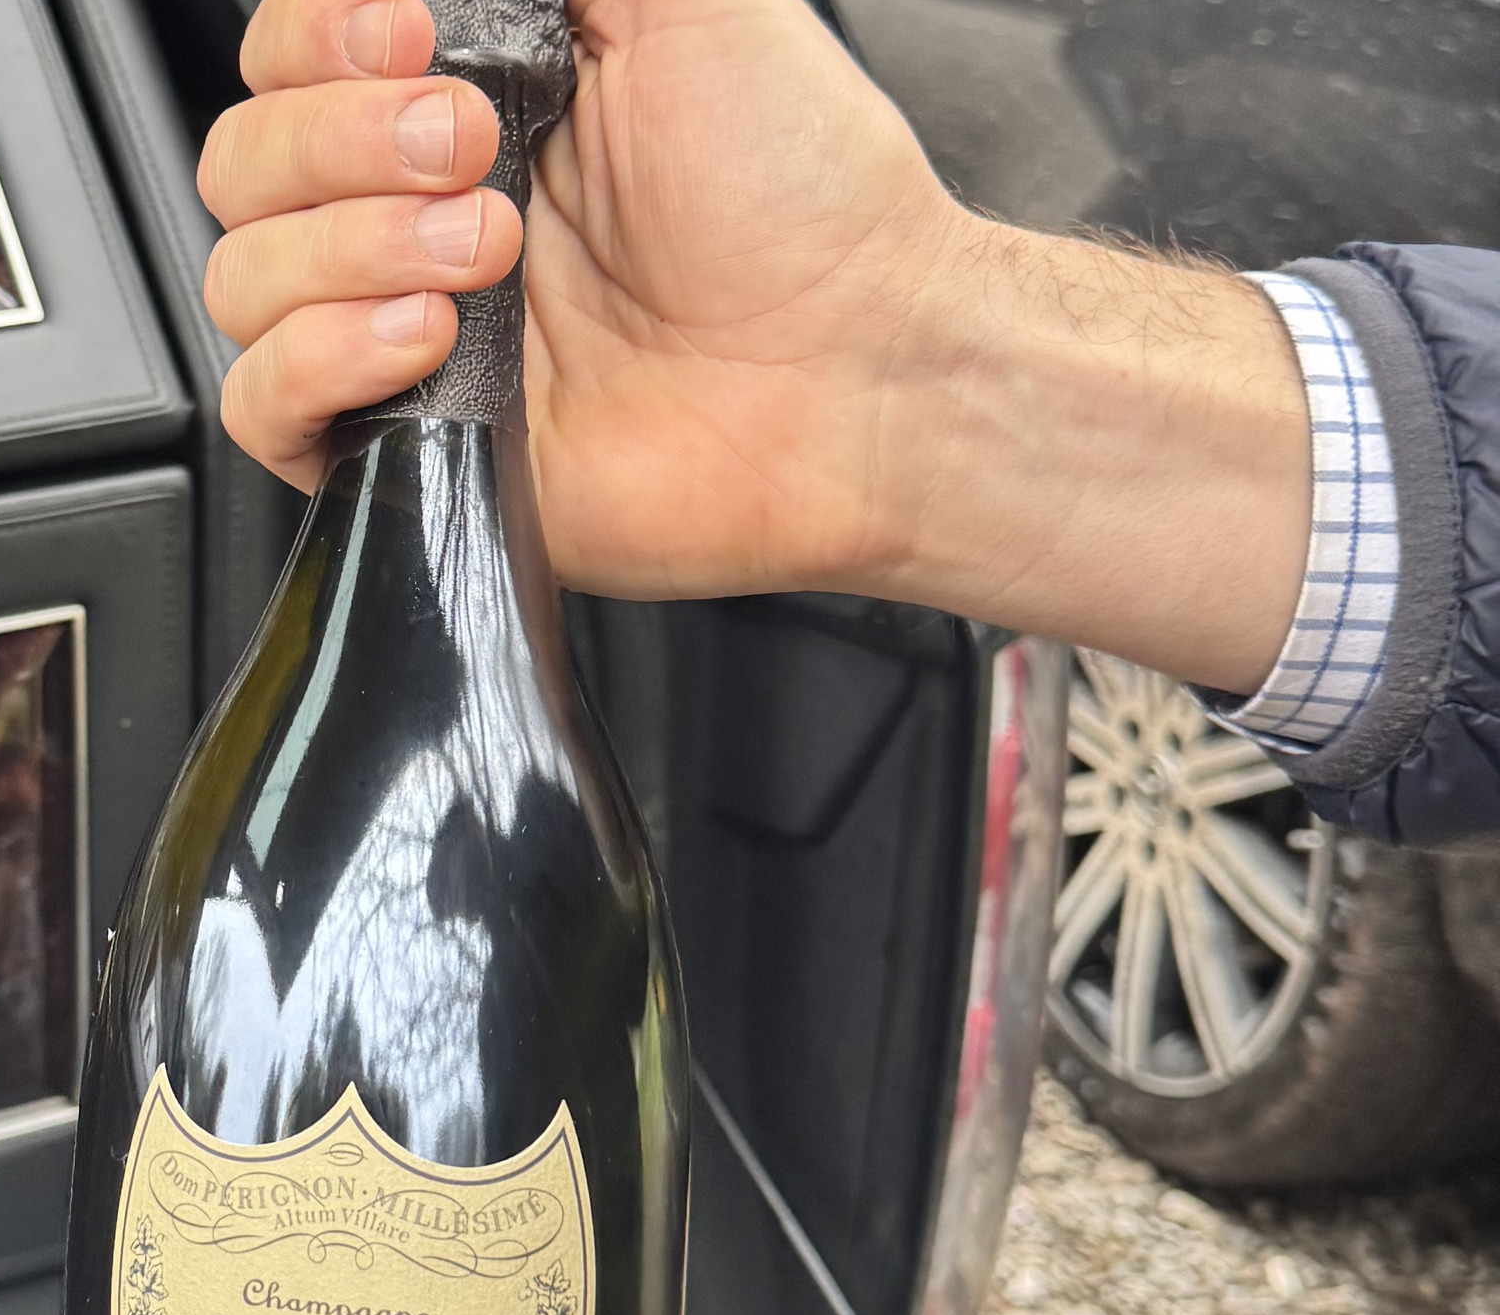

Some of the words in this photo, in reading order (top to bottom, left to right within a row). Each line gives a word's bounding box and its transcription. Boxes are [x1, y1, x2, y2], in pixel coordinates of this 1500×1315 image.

[160, 1154, 199, 1198] Dom
[273, 1206, 336, 1231] Altum
[343, 1207, 411, 1244] Villare
